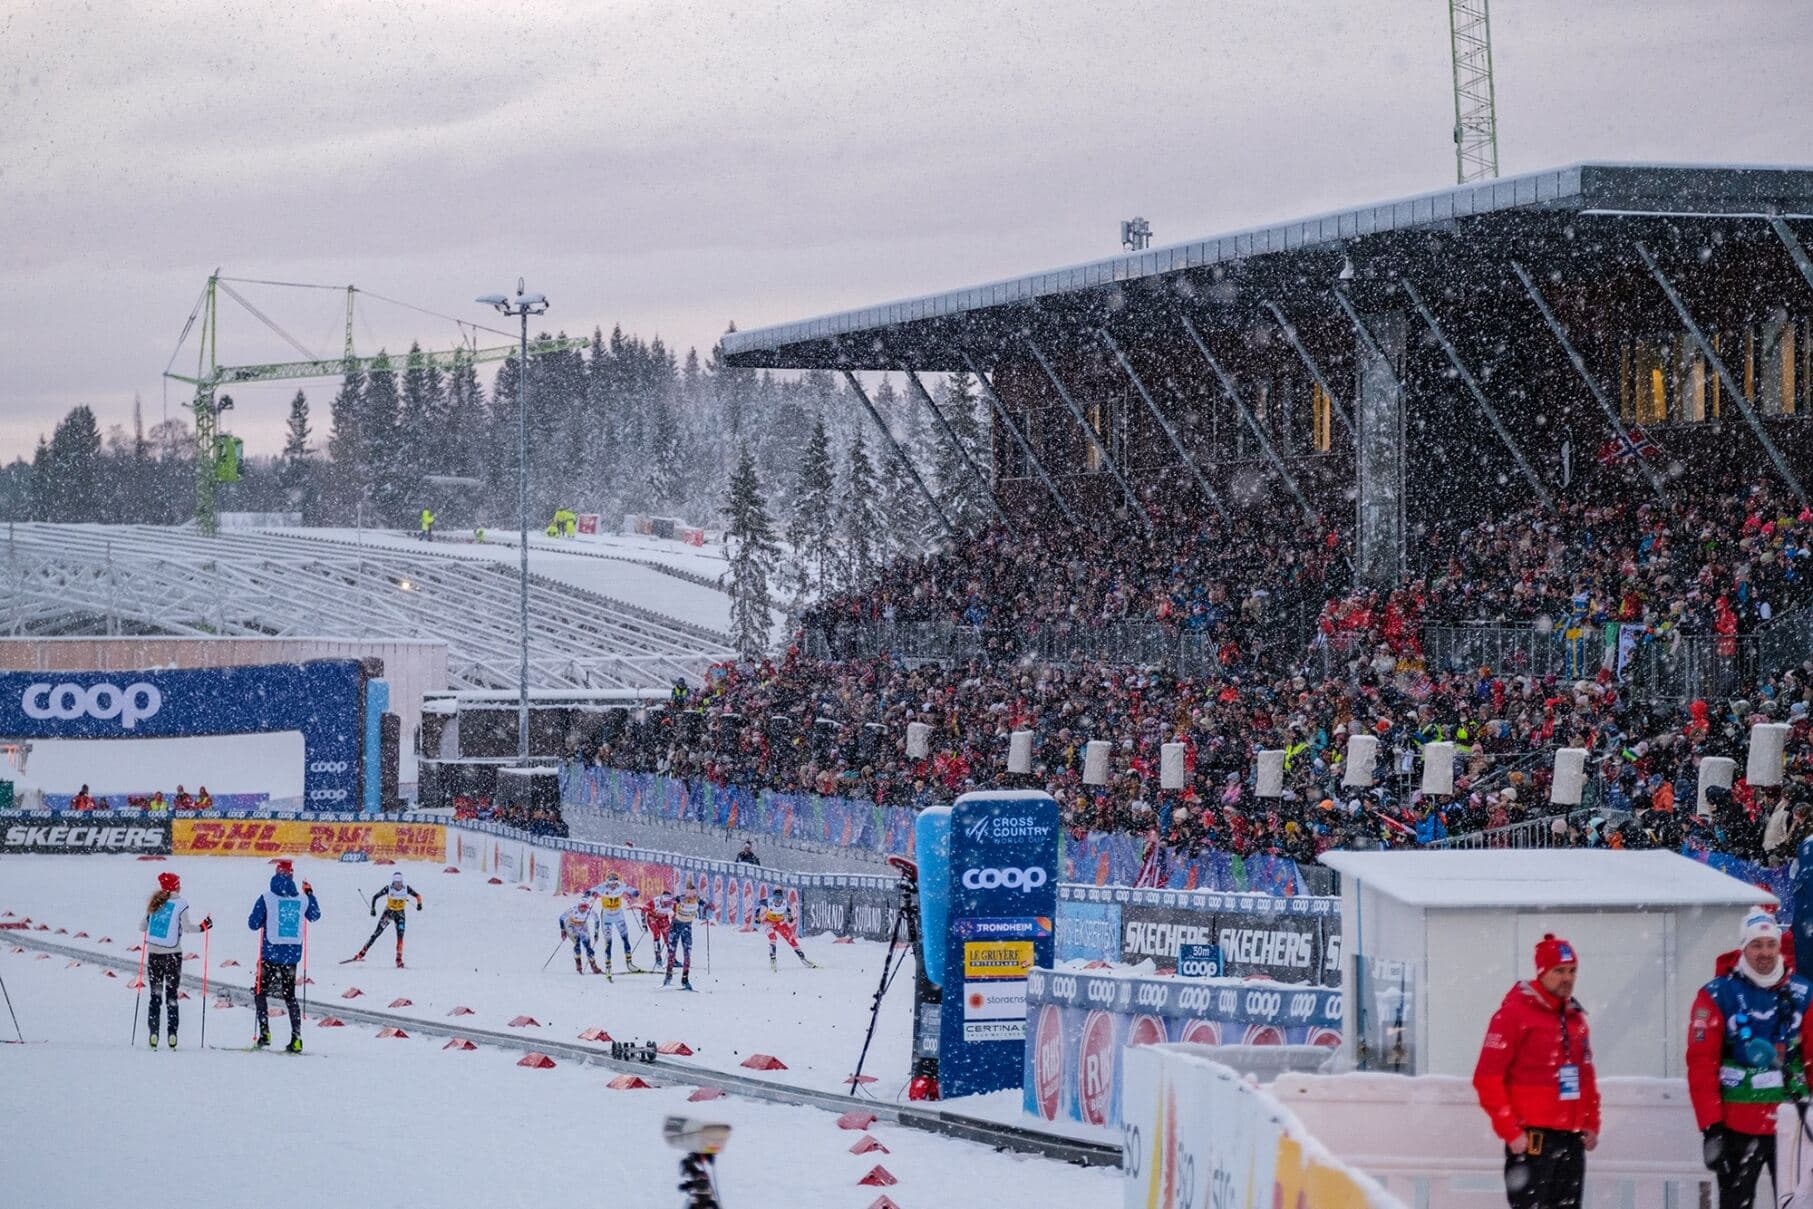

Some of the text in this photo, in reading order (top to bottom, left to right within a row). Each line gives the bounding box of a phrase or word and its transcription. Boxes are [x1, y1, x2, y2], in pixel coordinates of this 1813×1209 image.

[22, 683, 161, 728] coop
[310, 760, 347, 774] coop
[310, 789, 347, 801] coop
[993, 816, 1034, 827] CROSS
[5, 825, 165, 847] SKECHERS
[190, 823, 281, 851] DHL
[993, 826, 1049, 837] COUNTRY
[310, 826, 375, 854] DHL
[962, 866, 1046, 893] coop
[976, 923, 1033, 932] TRONDHEIM
[1193, 946, 1210, 956] 50m
[1220, 928, 1313, 968] SKECHERS
[1183, 961, 1218, 977] coop
[1053, 976, 1077, 1003] coop
[1088, 979, 1116, 1008] coop
[1139, 984, 1168, 1012] coop
[1179, 987, 1211, 1016] coop
[1246, 991, 1281, 1022] coop
[1290, 993, 1317, 1023] coop
[1325, 994, 1343, 1020] co
[966, 1024, 1020, 1033] CERTINA
